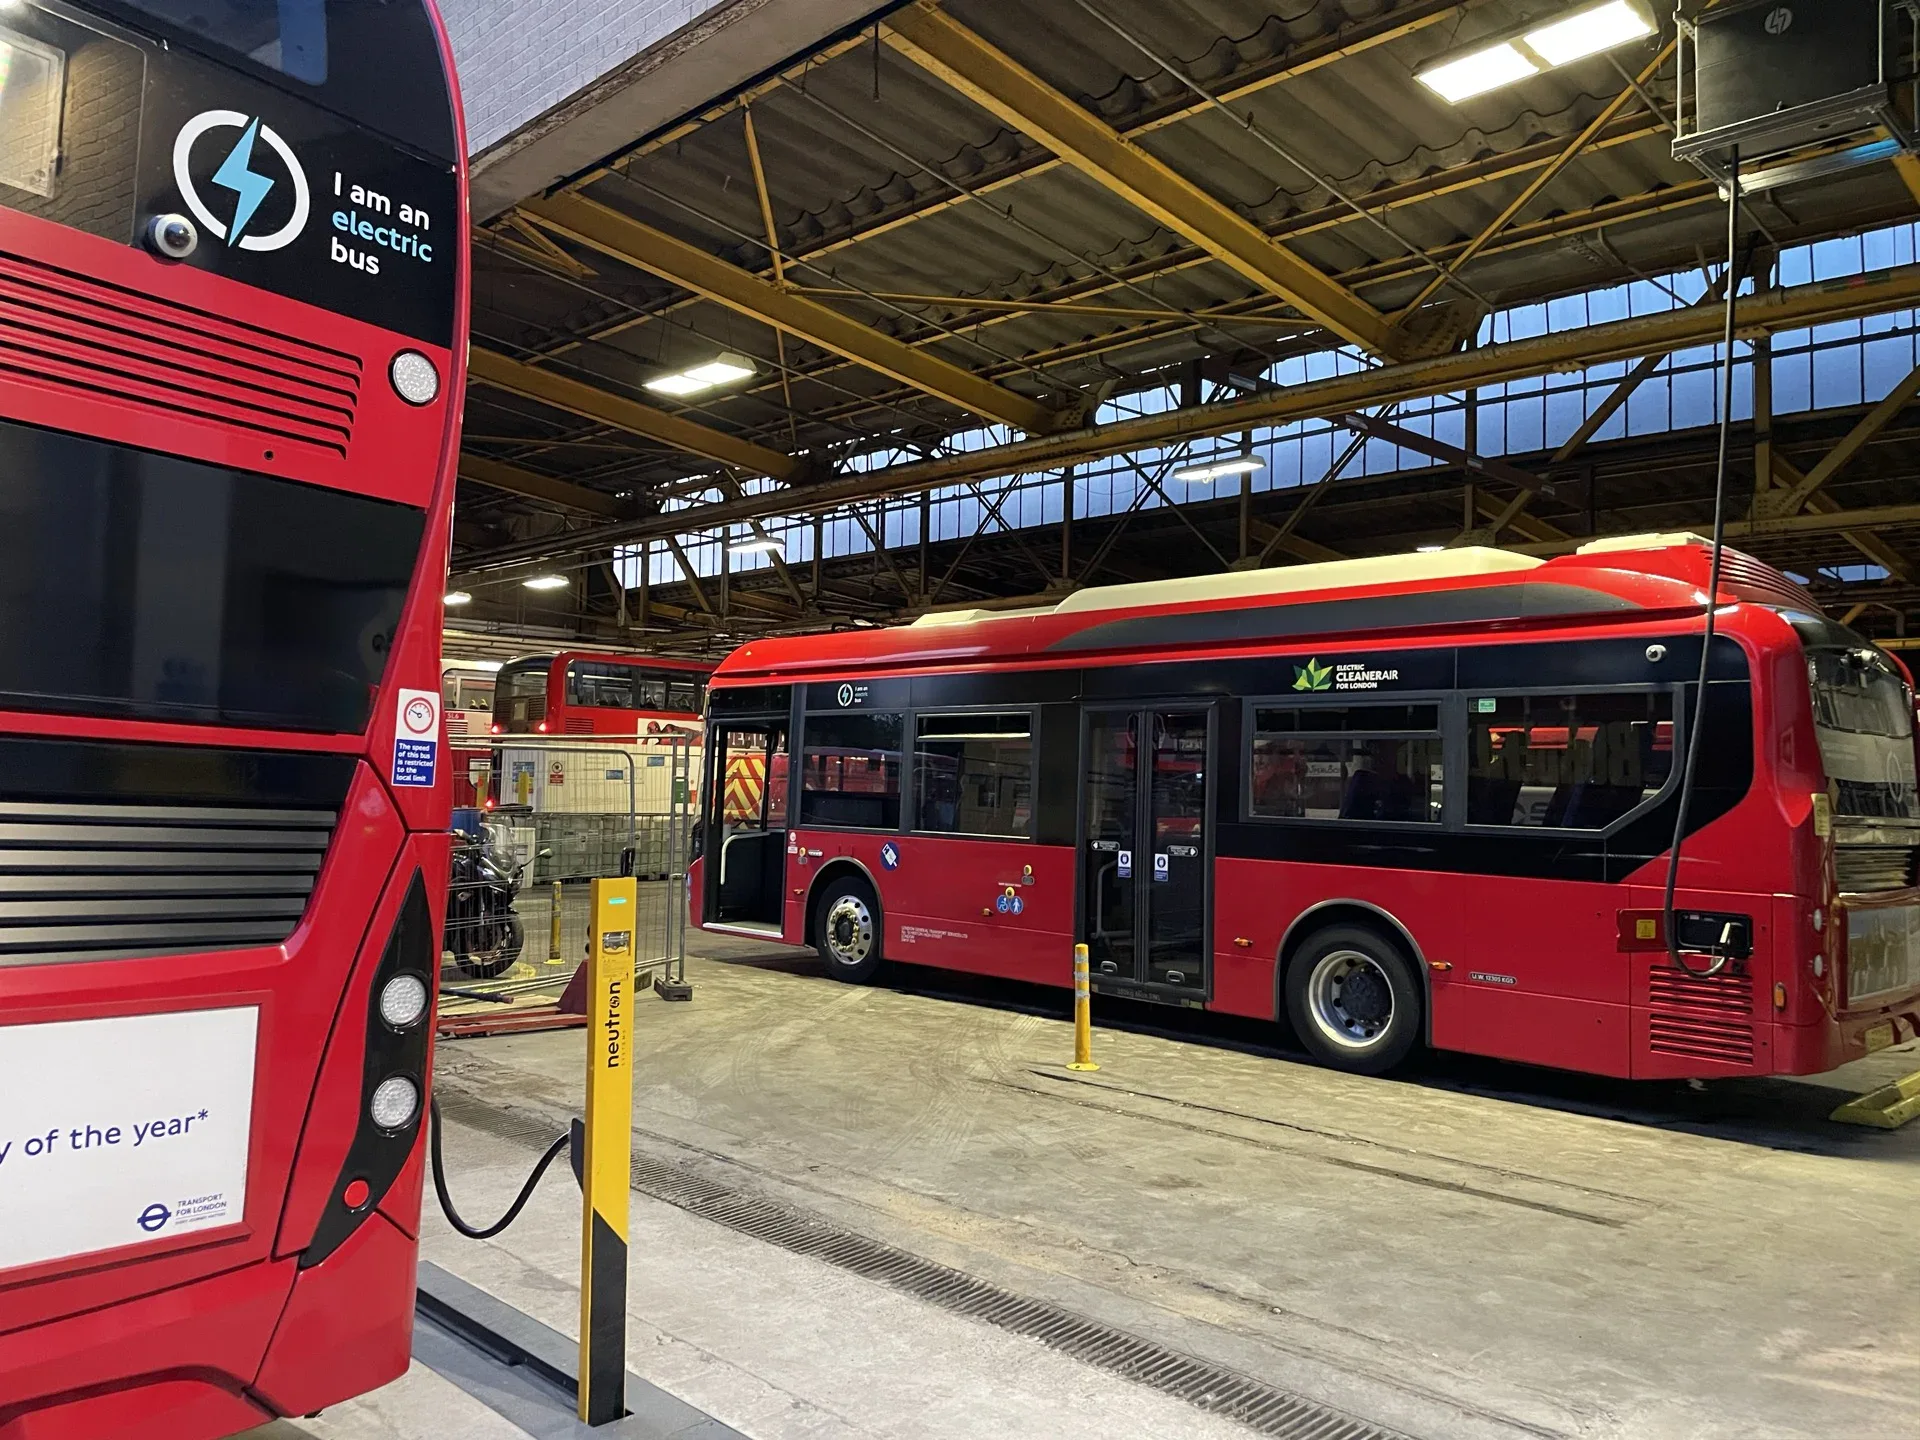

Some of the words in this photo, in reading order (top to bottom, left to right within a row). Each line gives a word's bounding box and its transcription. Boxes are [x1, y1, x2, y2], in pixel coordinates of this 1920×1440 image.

[334, 171, 342, 196] I
[350, 184, 391, 216] am
[398, 203, 430, 231] an
[332, 210, 433, 262] electric
[331, 236, 380, 275] bus
[1335, 669, 1399, 682] CLEANERAIR
[1336, 664, 1365, 672] ELECTRIC
[1336, 682, 1349, 690] FOR
[1349, 681, 1378, 690] LONDON
[398, 742, 411, 750] The
[404, 759, 434, 767] restricted
[396, 773, 412, 781] local
[412, 774, 426, 782] limit
[605, 981, 621, 1068] neutron
[24, 1129, 59, 1156] of
[69, 1125, 121, 1150] the
[178, 1193, 223, 1208] TRANSPORT
[175, 1207, 192, 1217] FOR
[193, 1201, 227, 1213] LONDON
